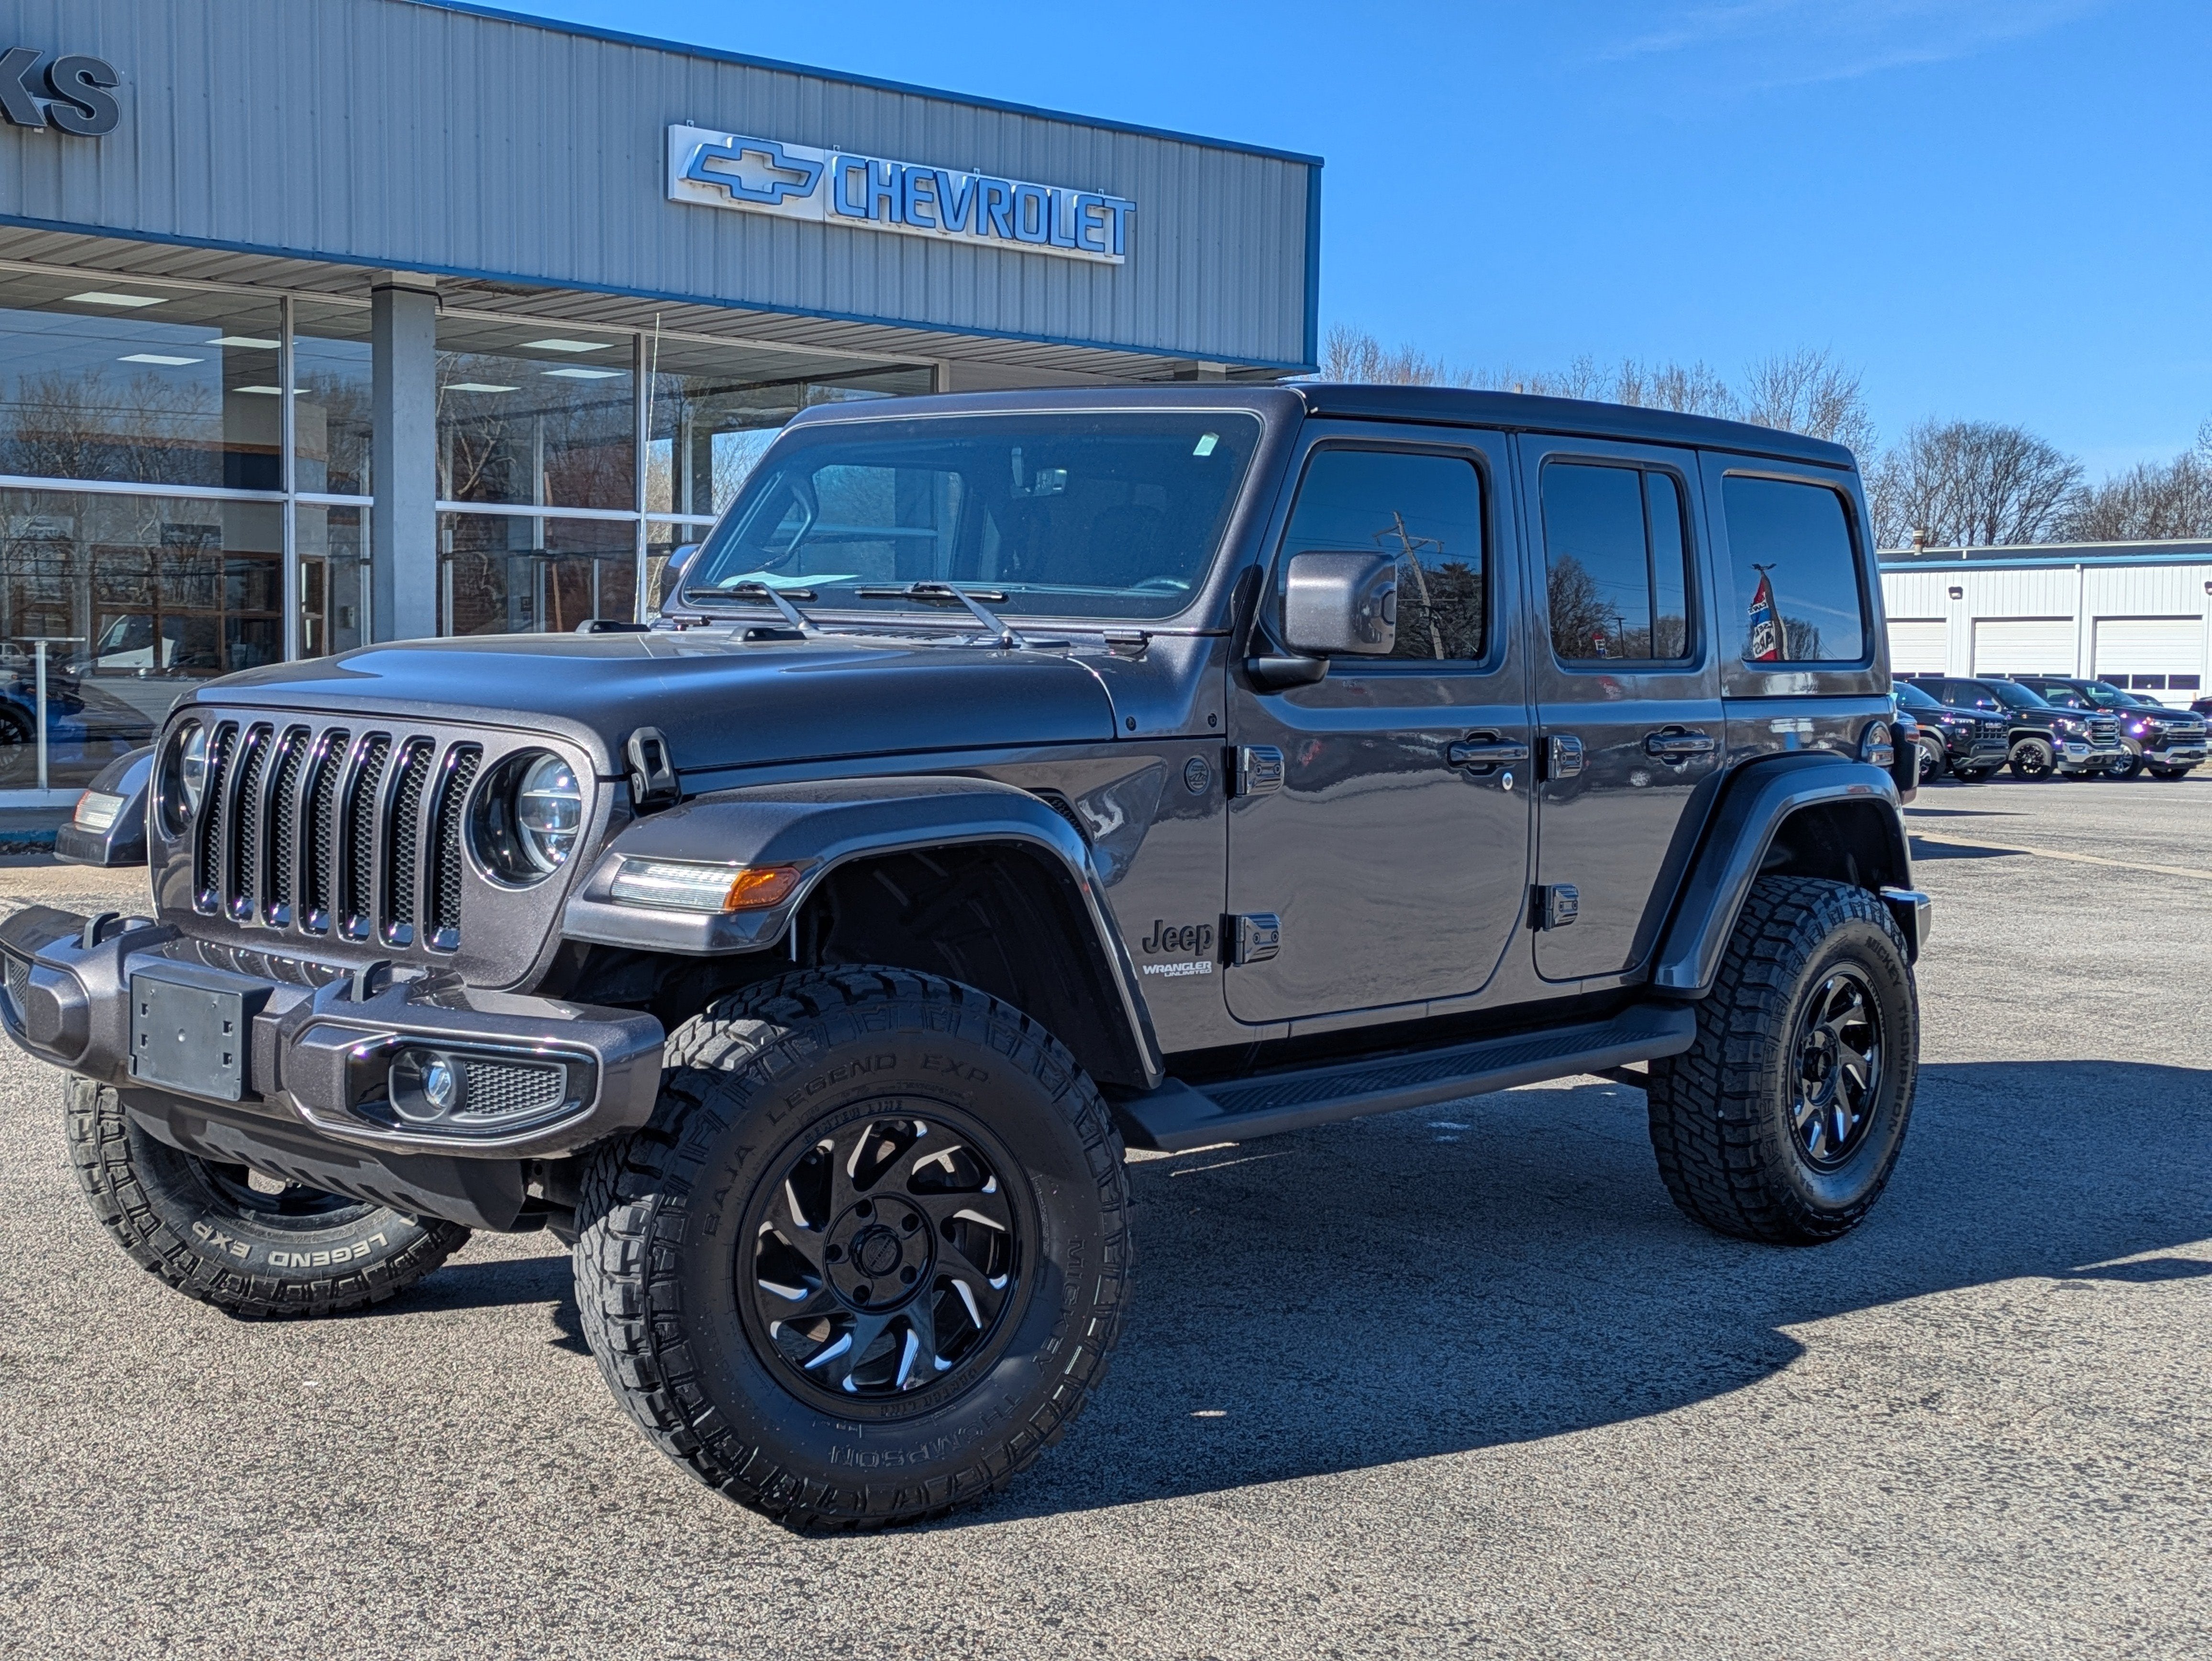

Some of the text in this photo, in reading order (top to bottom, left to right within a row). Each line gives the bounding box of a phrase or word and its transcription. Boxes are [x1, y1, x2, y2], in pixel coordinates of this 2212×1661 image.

[831, 155, 1137, 256] CHEVROLET
[1142, 919, 1214, 956] Jeep
[1142, 960, 1212, 974] WRANGLER
[1164, 968, 1212, 977] UNLIMITED
[1865, 935, 1902, 987] MICKEY
[1888, 999, 1910, 1135] THOMPSON
[702, 1144, 757, 1237] BAJA
[765, 1053, 898, 1126] LEGEND
[920, 1053, 992, 1085] EXP
[192, 1220, 253, 1259] EXP
[268, 1233, 388, 1268] LEGEND
[828, 1238, 1086, 1469] MICKEY THOMPSON
